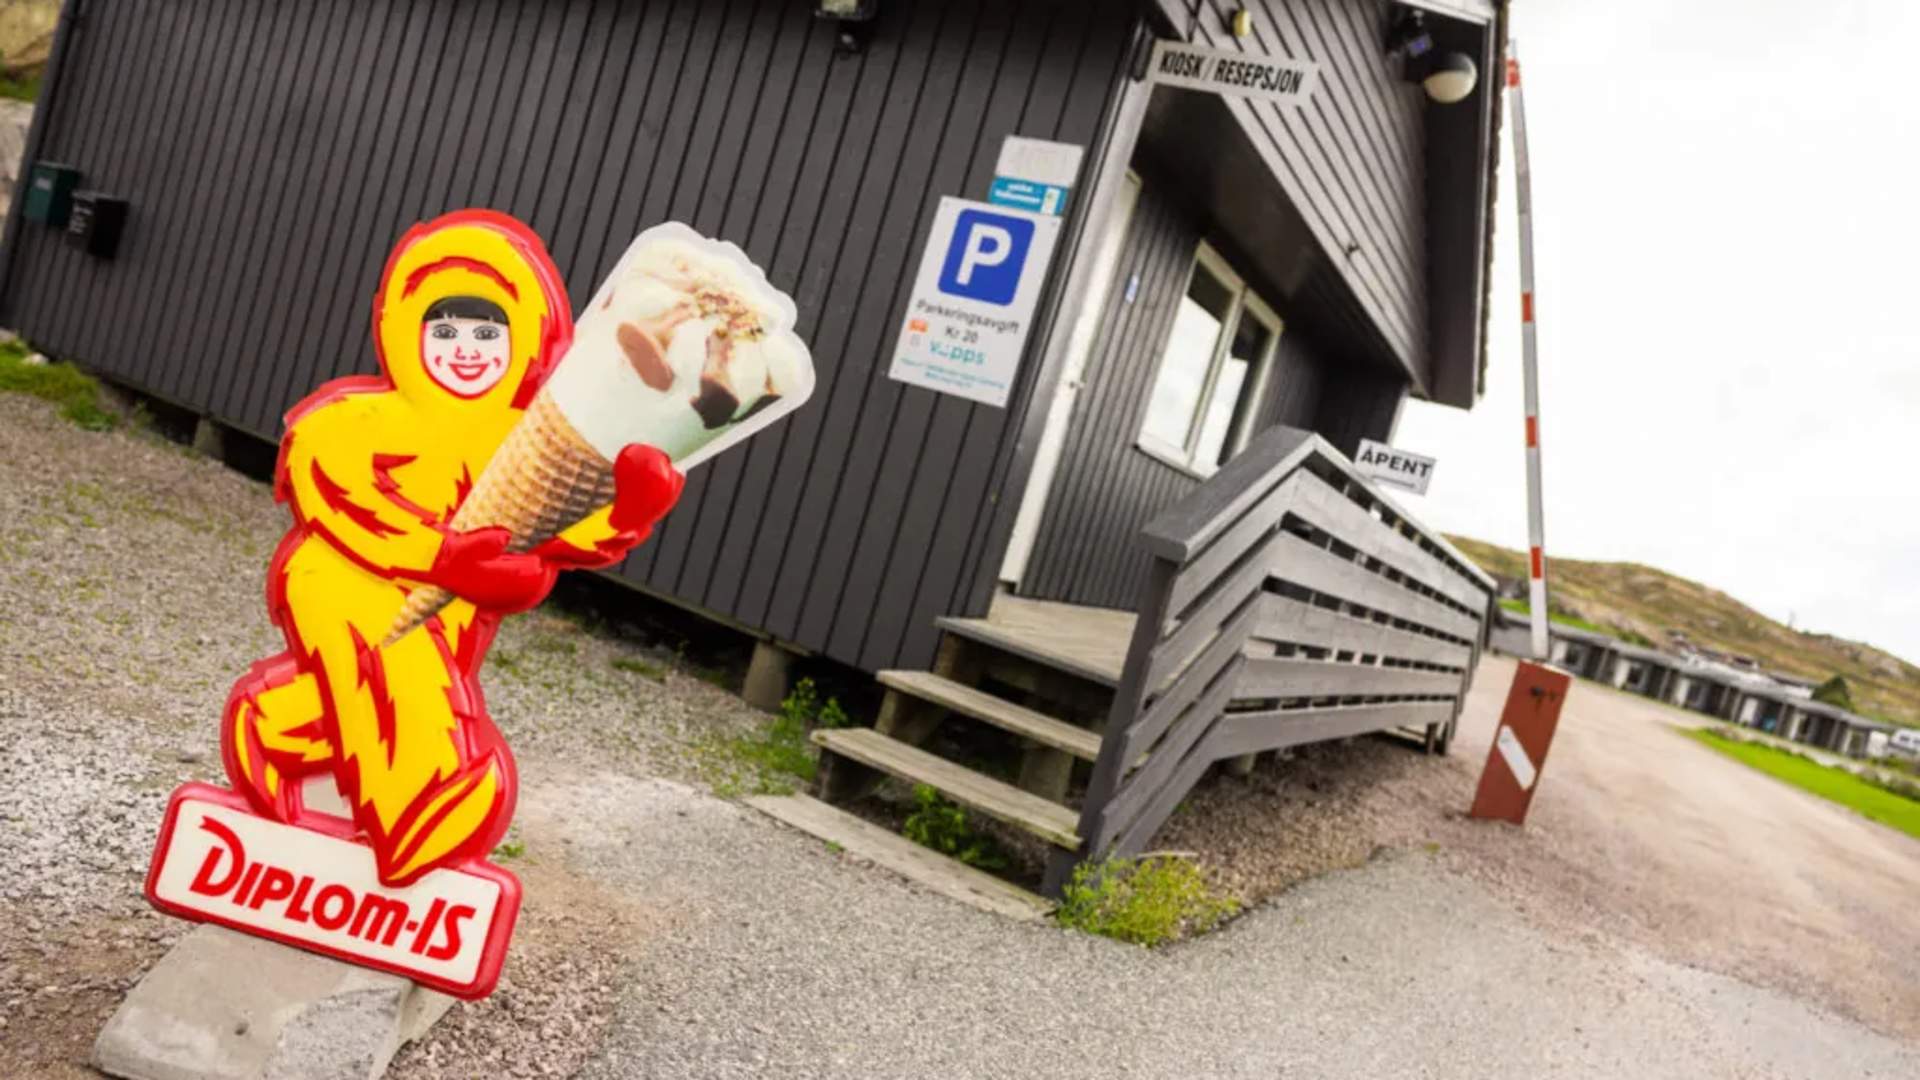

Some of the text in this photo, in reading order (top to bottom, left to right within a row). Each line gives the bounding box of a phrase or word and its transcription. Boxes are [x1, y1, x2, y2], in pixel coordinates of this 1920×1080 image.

[1159, 50, 1205, 78] KIOSK
[1214, 58, 1304, 95] RESEPSJON
[956, 222, 1013, 286] P
[917, 299, 1020, 334] Parkeringsavgift
[1361, 445, 1432, 478] ÅPENT
